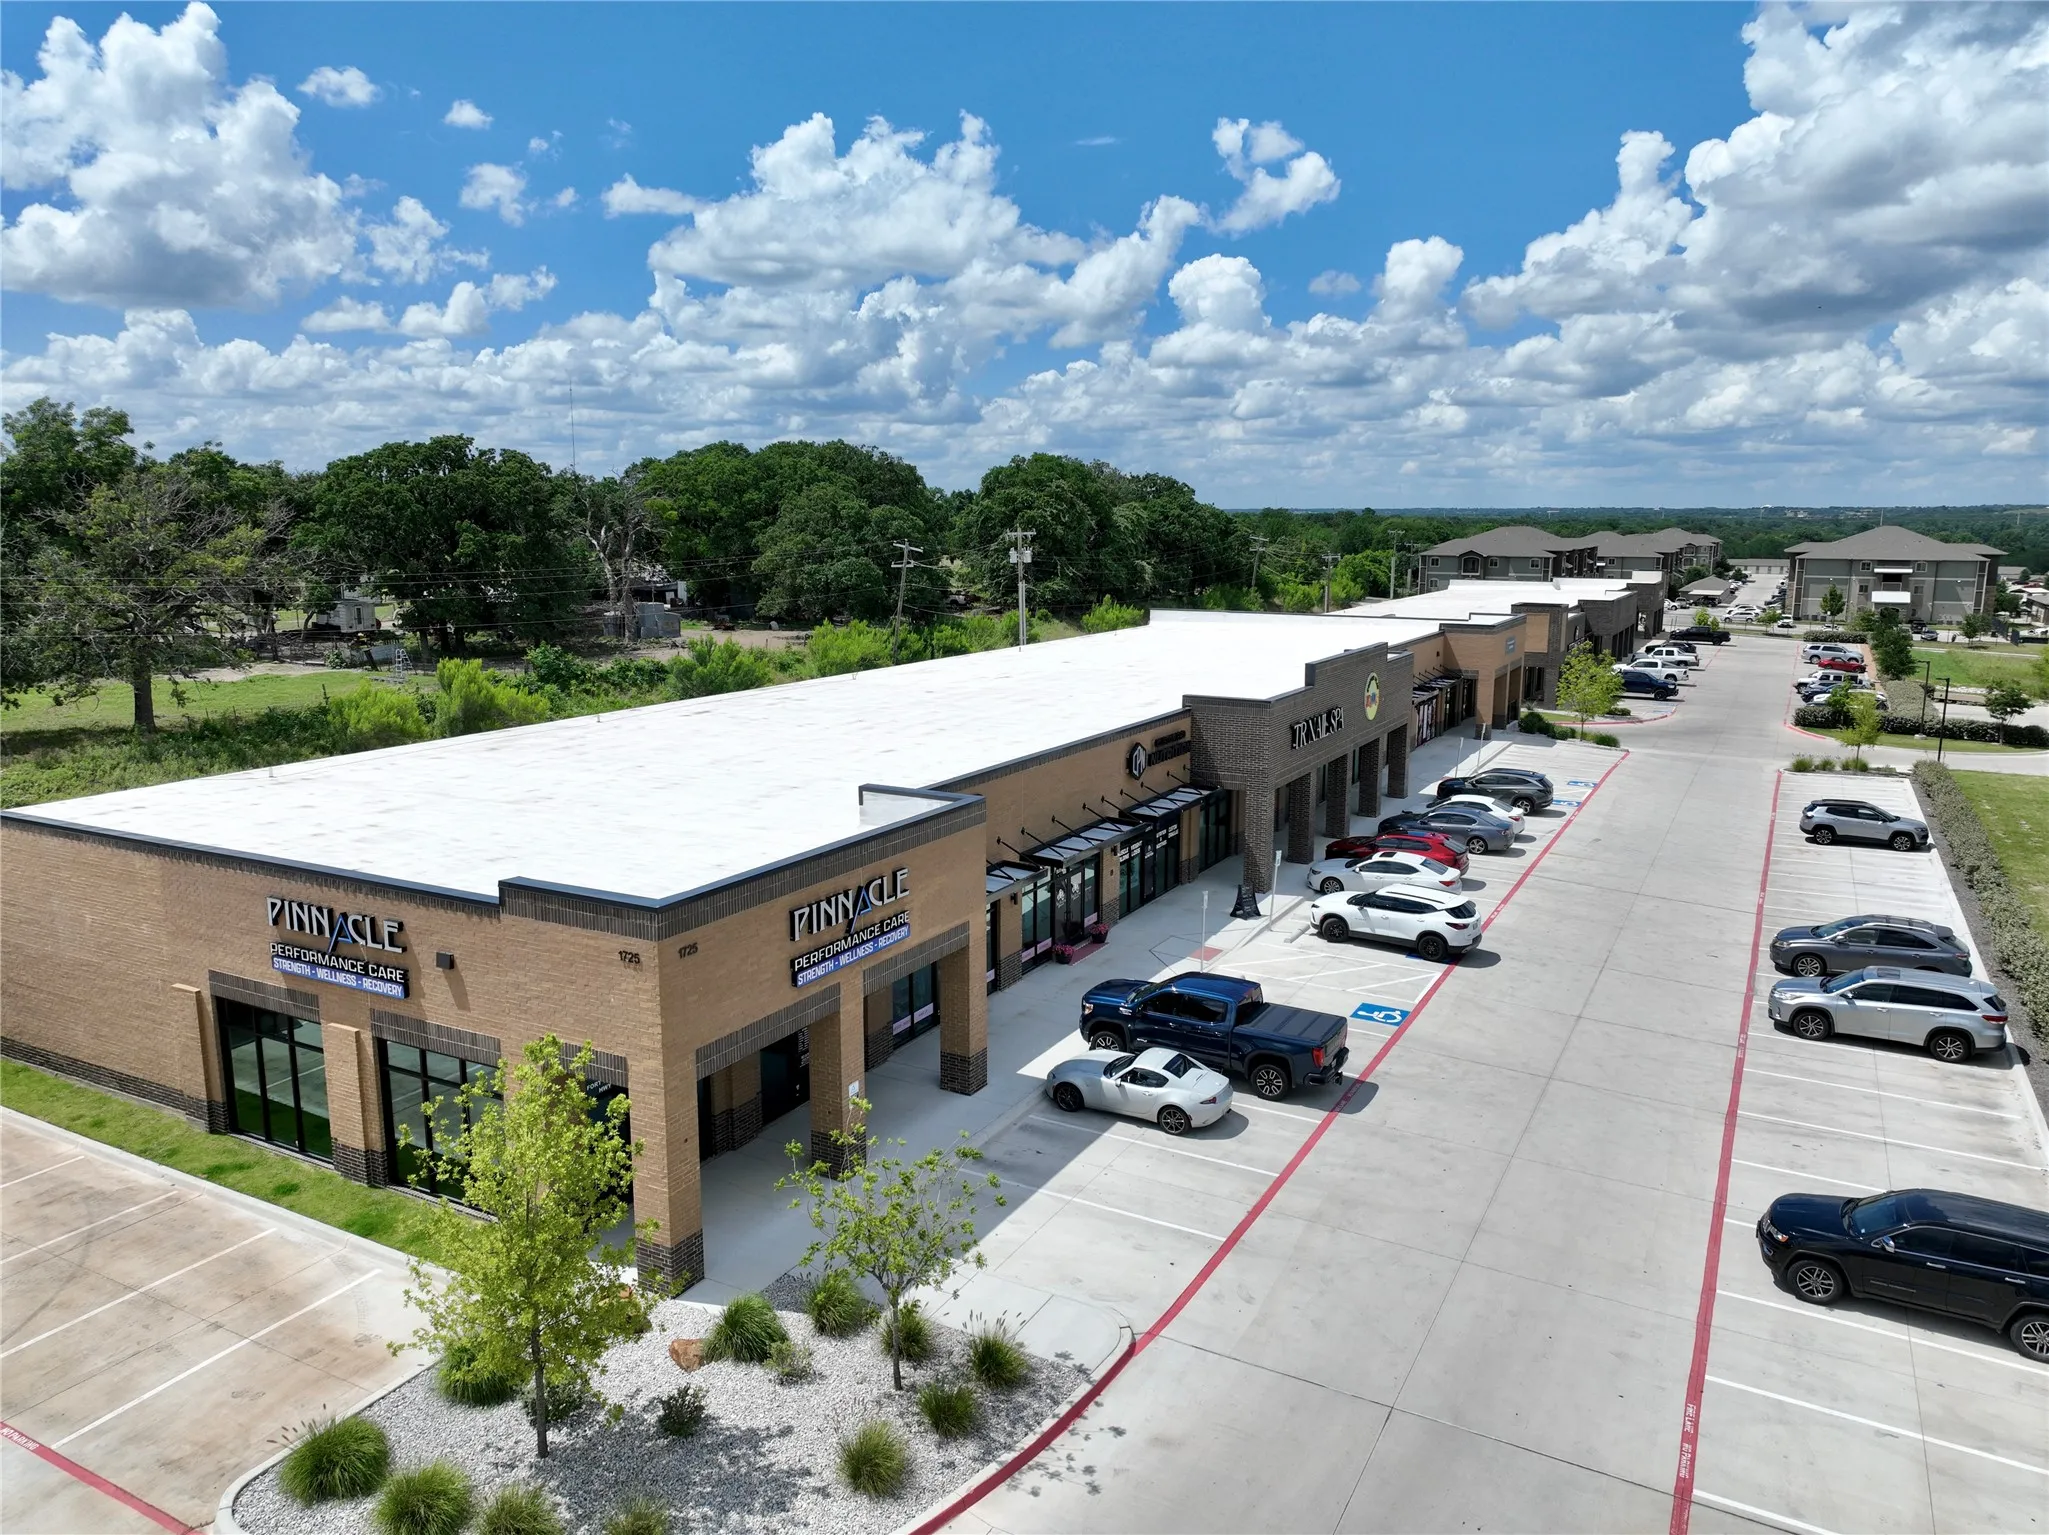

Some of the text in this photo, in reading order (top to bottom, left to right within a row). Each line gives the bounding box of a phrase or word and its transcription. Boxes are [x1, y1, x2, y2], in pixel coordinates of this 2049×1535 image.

[1329, 706, 1344, 735] SPA
[794, 868, 910, 942] PINNACLE
[266, 897, 403, 954] PINNACLE
[794, 911, 910, 972] PERFORMANCE CARE
[270, 942, 405, 983] PERFORMANCE CARE
[618, 950, 641, 964] 1725
[678, 942, 698, 959] 1725
[797, 959, 834, 986] STRENGTH
[839, 941, 874, 967] WELLNESS
[878, 926, 909, 949] RECOVERY
[273, 958, 311, 975] STRENGTH
[316, 967, 357, 986] WELLNESS
[363, 977, 403, 997] RECOVERY
[12, 1431, 40, 1451] PARKING
